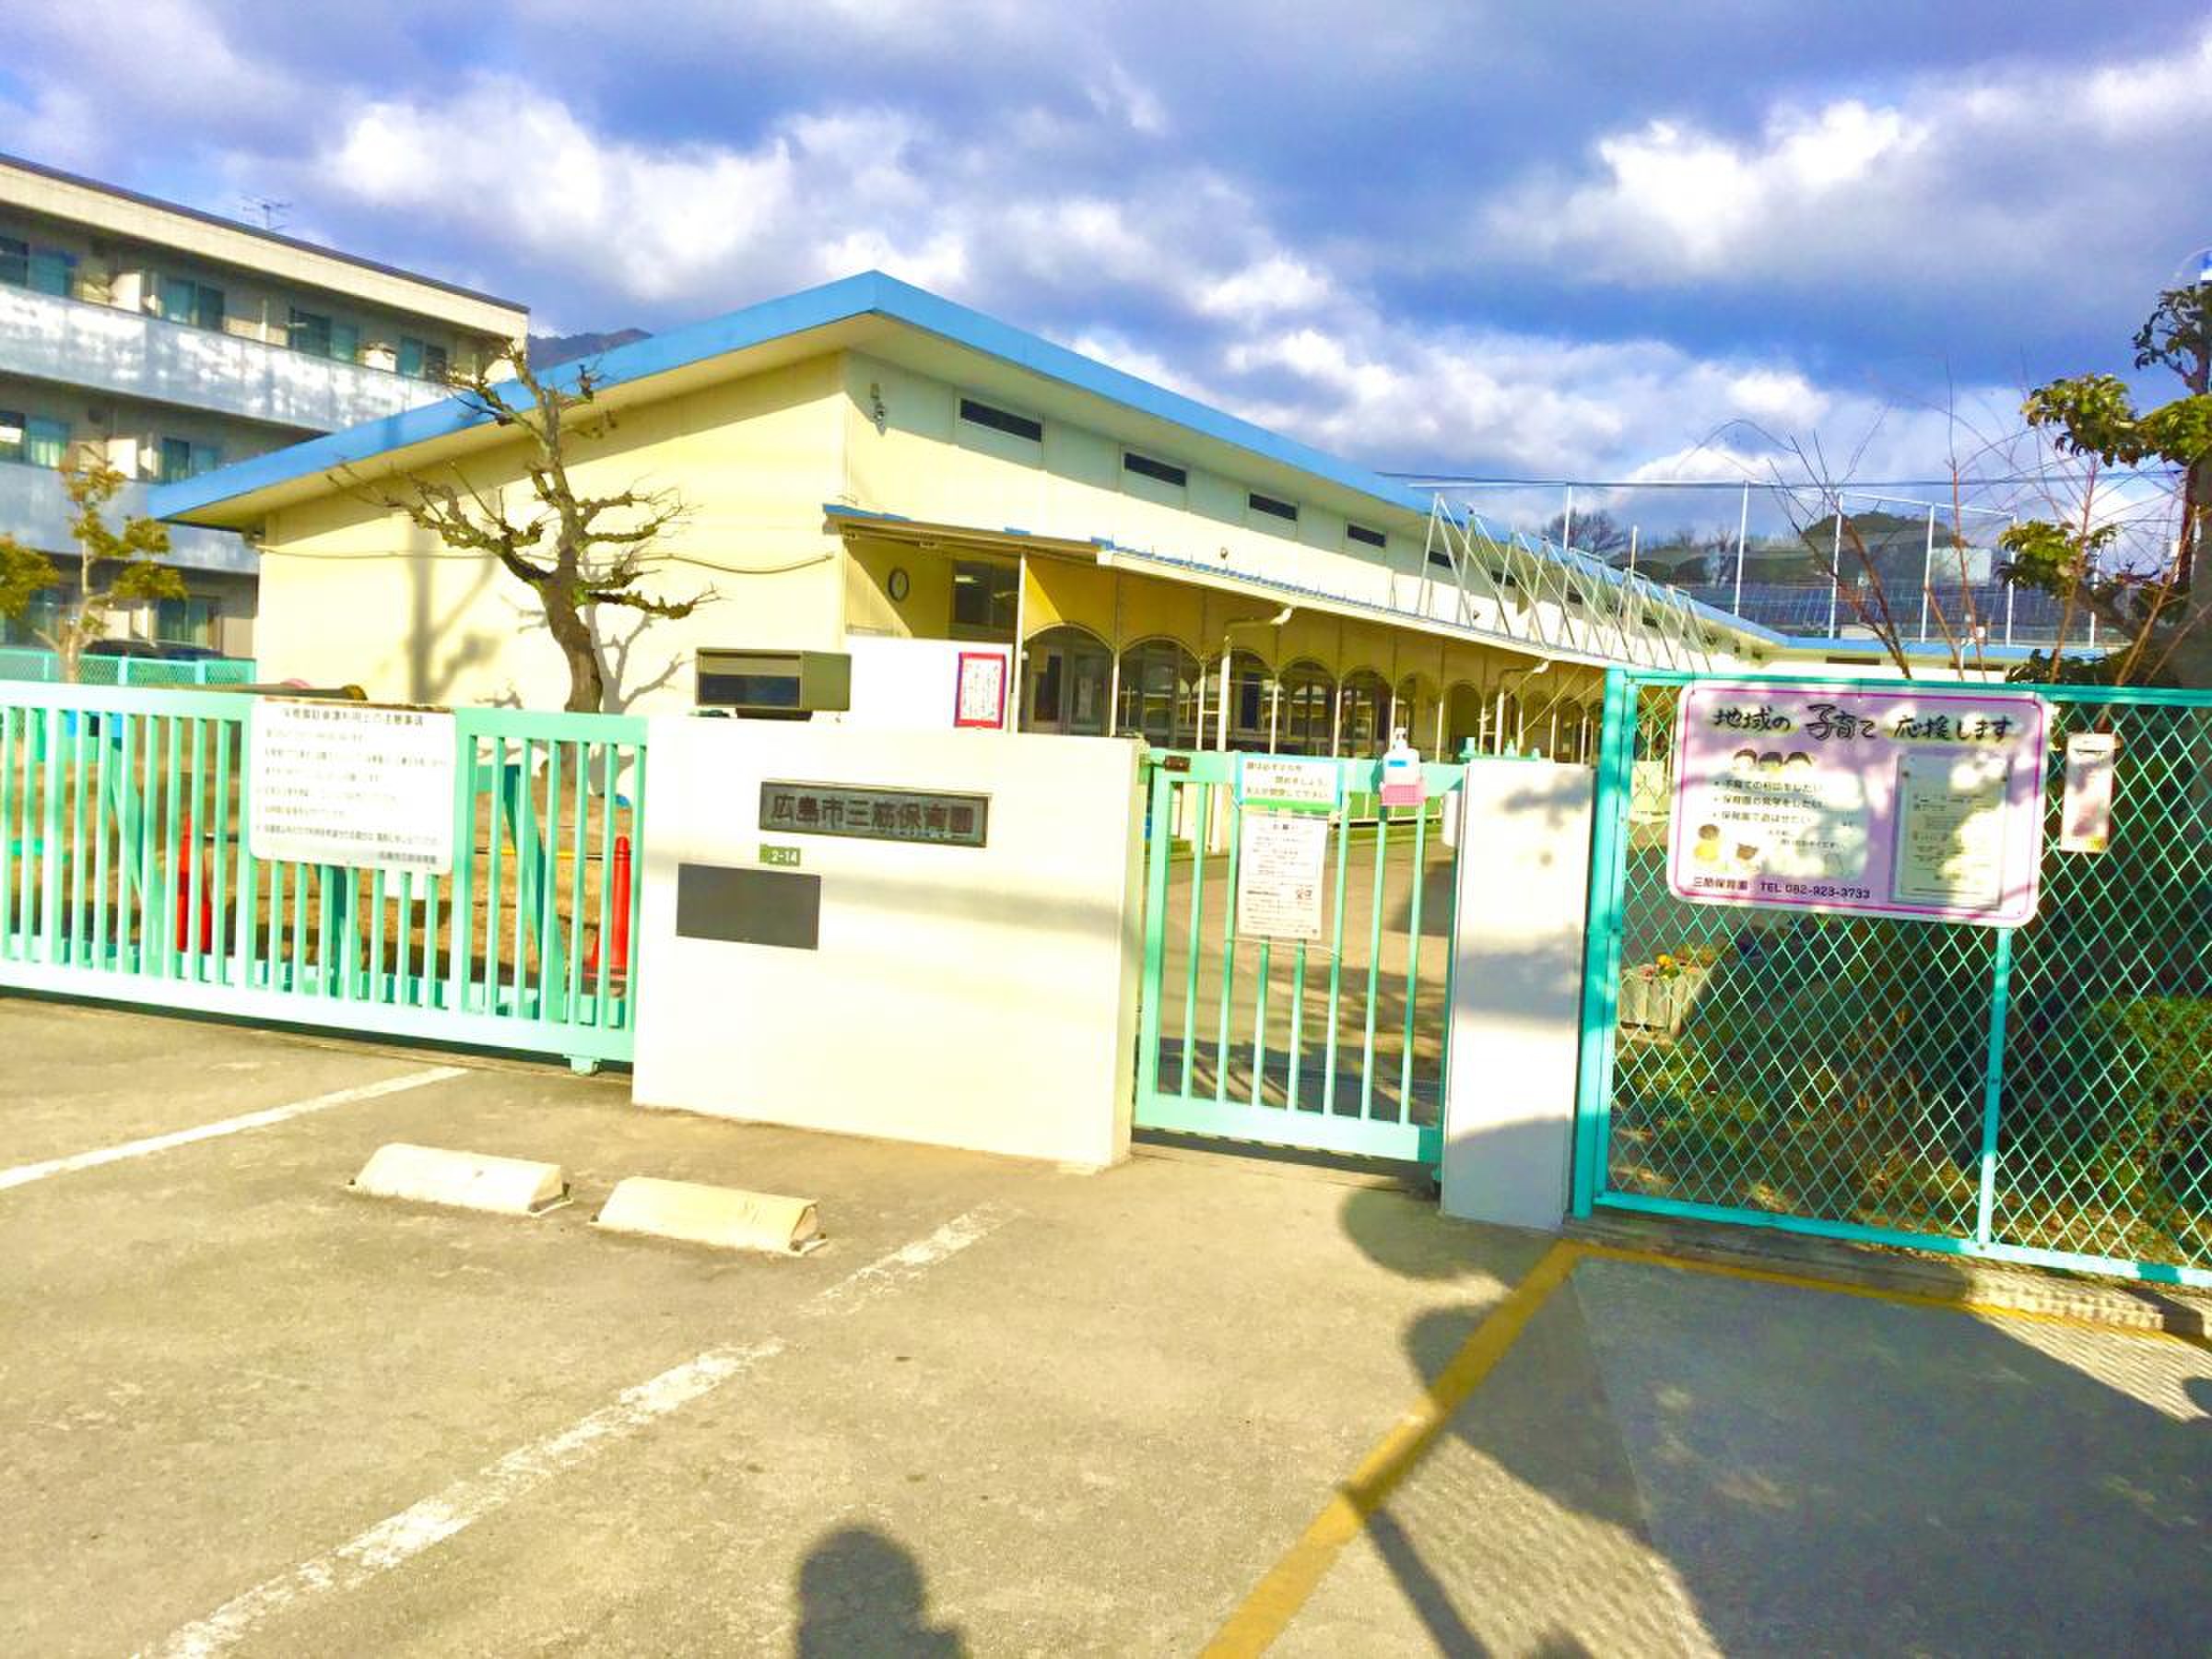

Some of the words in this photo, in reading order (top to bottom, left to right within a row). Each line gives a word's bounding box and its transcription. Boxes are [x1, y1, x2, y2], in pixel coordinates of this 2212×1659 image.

[1712, 706, 1791, 733] 地域の
[1806, 702, 1877, 740] 子育て
[1892, 713, 2013, 741] 応援します
[771, 794, 974, 834] 広島市三筋保育園
[1760, 881, 1782, 893] TEL
[1784, 884, 1871, 900] 082-923-3733
